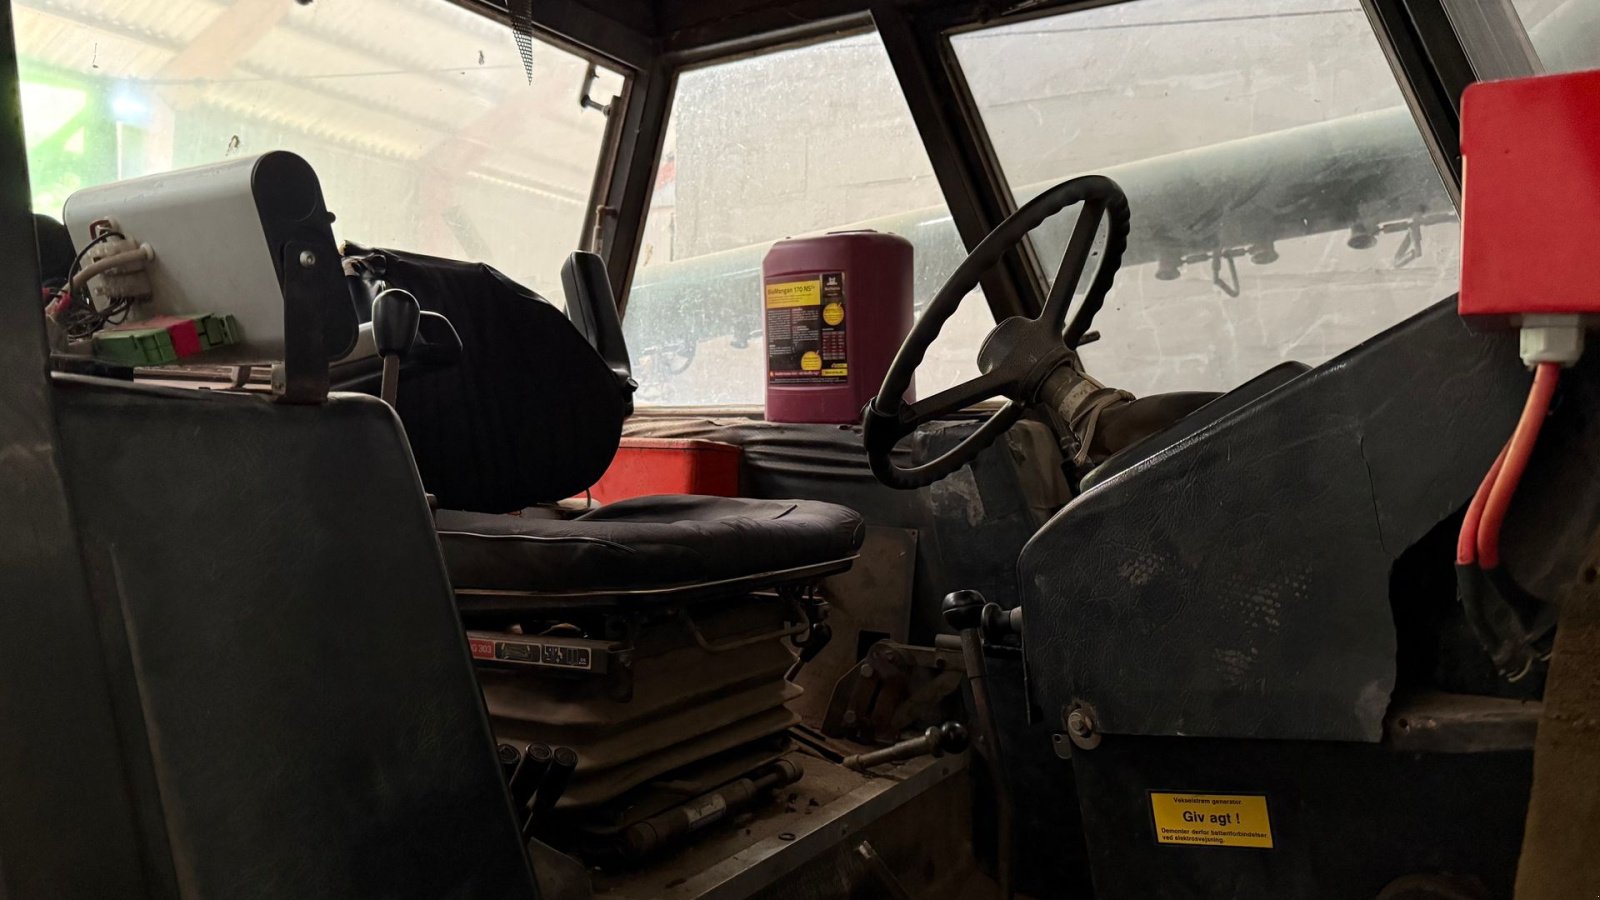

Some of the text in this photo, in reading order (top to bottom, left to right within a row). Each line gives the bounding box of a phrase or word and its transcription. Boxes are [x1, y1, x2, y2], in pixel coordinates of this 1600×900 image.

[478, 645, 492, 653] 303
[1183, 811, 1240, 826] Giv agt !
